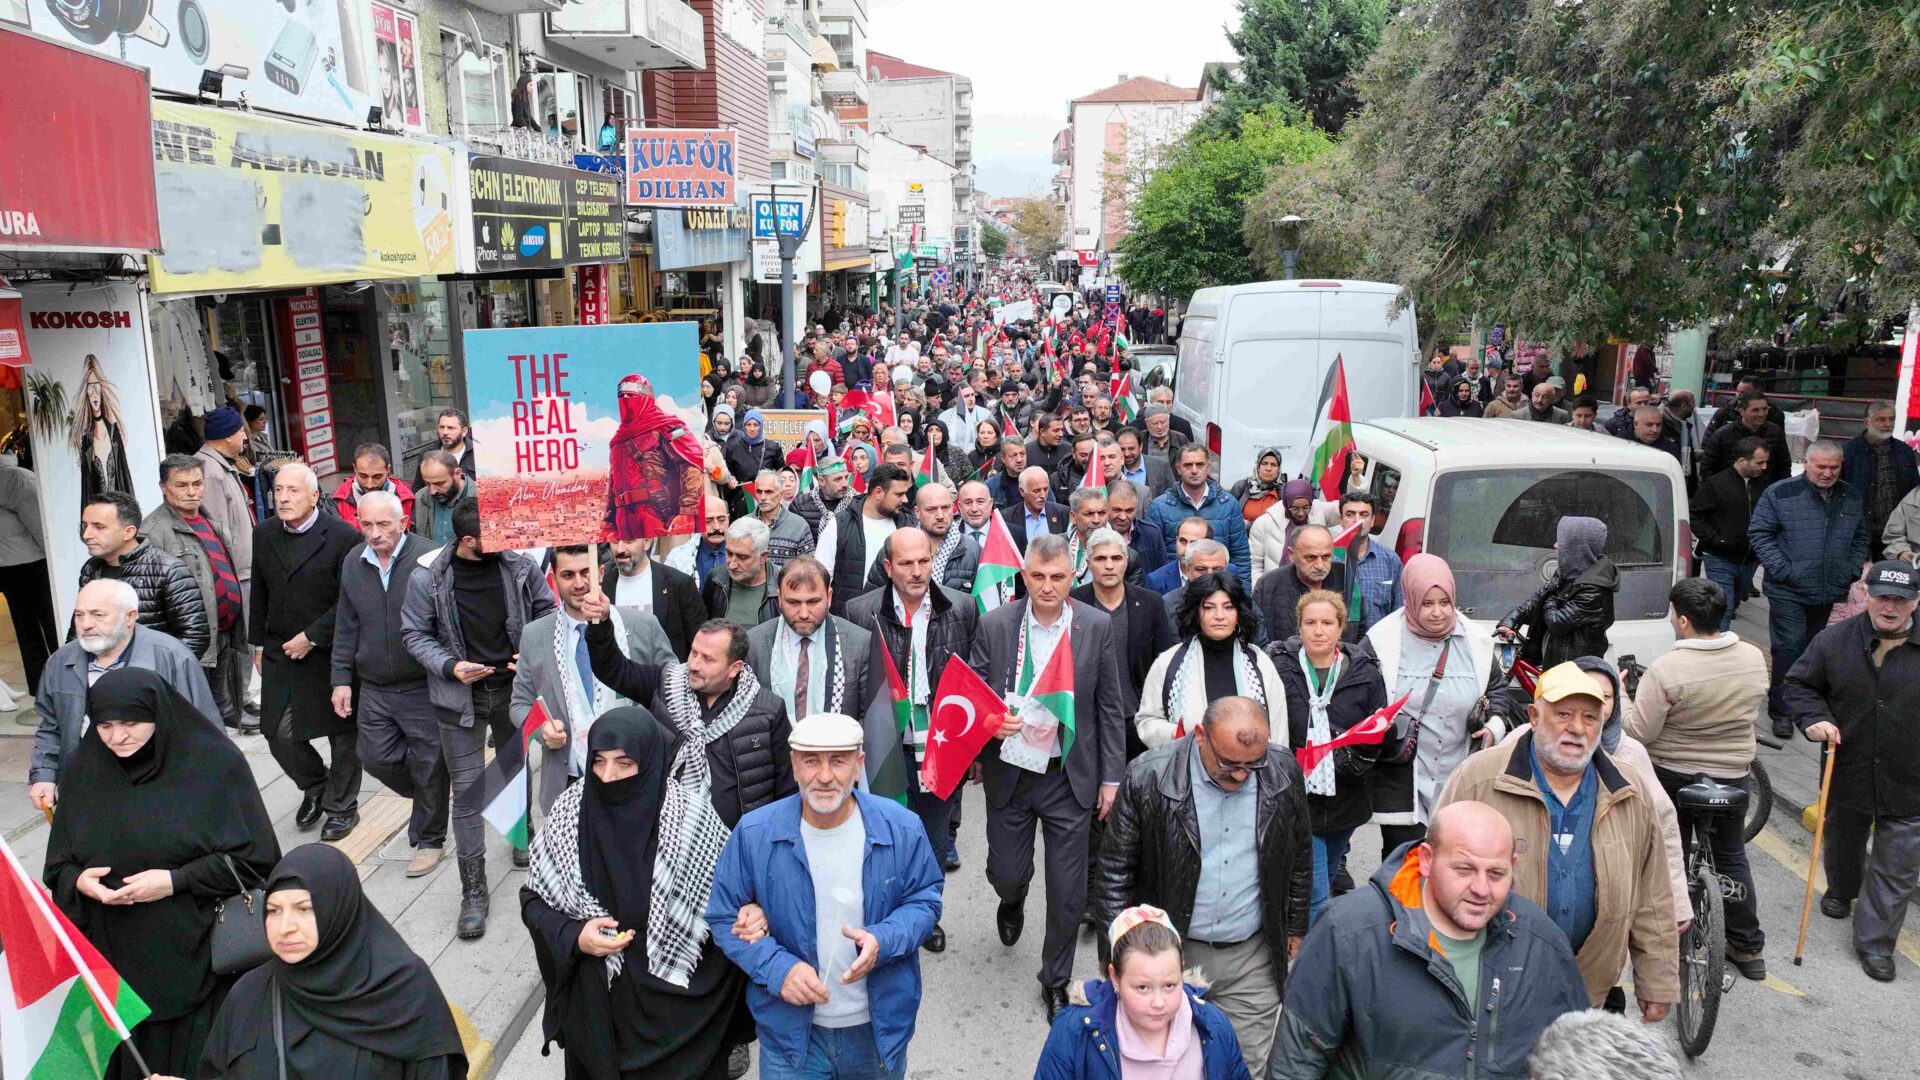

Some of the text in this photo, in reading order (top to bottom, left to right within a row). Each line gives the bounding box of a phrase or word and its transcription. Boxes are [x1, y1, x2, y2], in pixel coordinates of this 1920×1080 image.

[631, 132, 734, 176] KUAFÖR
[576, 179, 617, 197] CEP TELEFONU
[638, 175, 726, 199] DİLHAN
[578, 222, 622, 237] LAPTOP TABLET
[760, 217, 799, 232] KUFÖR
[522, 234, 545, 246] SAMSUNG
[579, 240, 601, 258] TEKNİK
[476, 246, 498, 261] iPhone
[30, 311, 132, 329] KOKOSH
[507, 353, 570, 399] THE
[512, 399, 577, 436] REAL
[763, 421, 779, 434] CEP
[516, 438, 579, 473] HERO
[509, 475, 590, 507] Abu Ubaidah
[1880, 570, 1910, 581] BOSS
